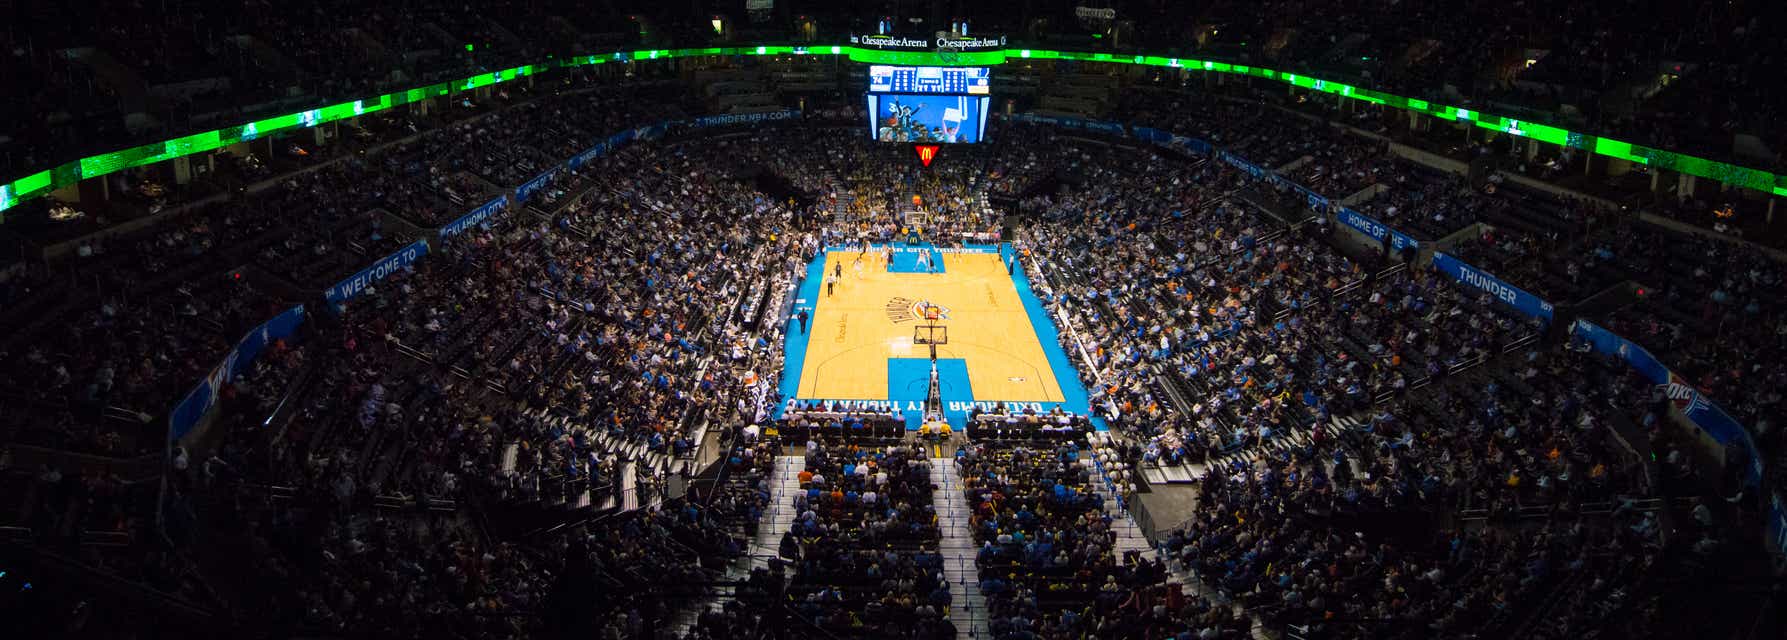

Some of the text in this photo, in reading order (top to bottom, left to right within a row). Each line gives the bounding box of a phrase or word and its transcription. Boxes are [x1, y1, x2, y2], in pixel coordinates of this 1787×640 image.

[861, 34, 901, 49] Chesapeake
[901, 37, 928, 48] Arena
[936, 37, 982, 51] Chesapeake
[982, 38, 998, 47] Arena
[1347, 213, 1371, 233] HOME
[1371, 225, 1385, 239] OF
[341, 248, 416, 299] WELCOME TO
[1459, 266, 1517, 305] THUNDER
[1665, 382, 1692, 400] OKC
